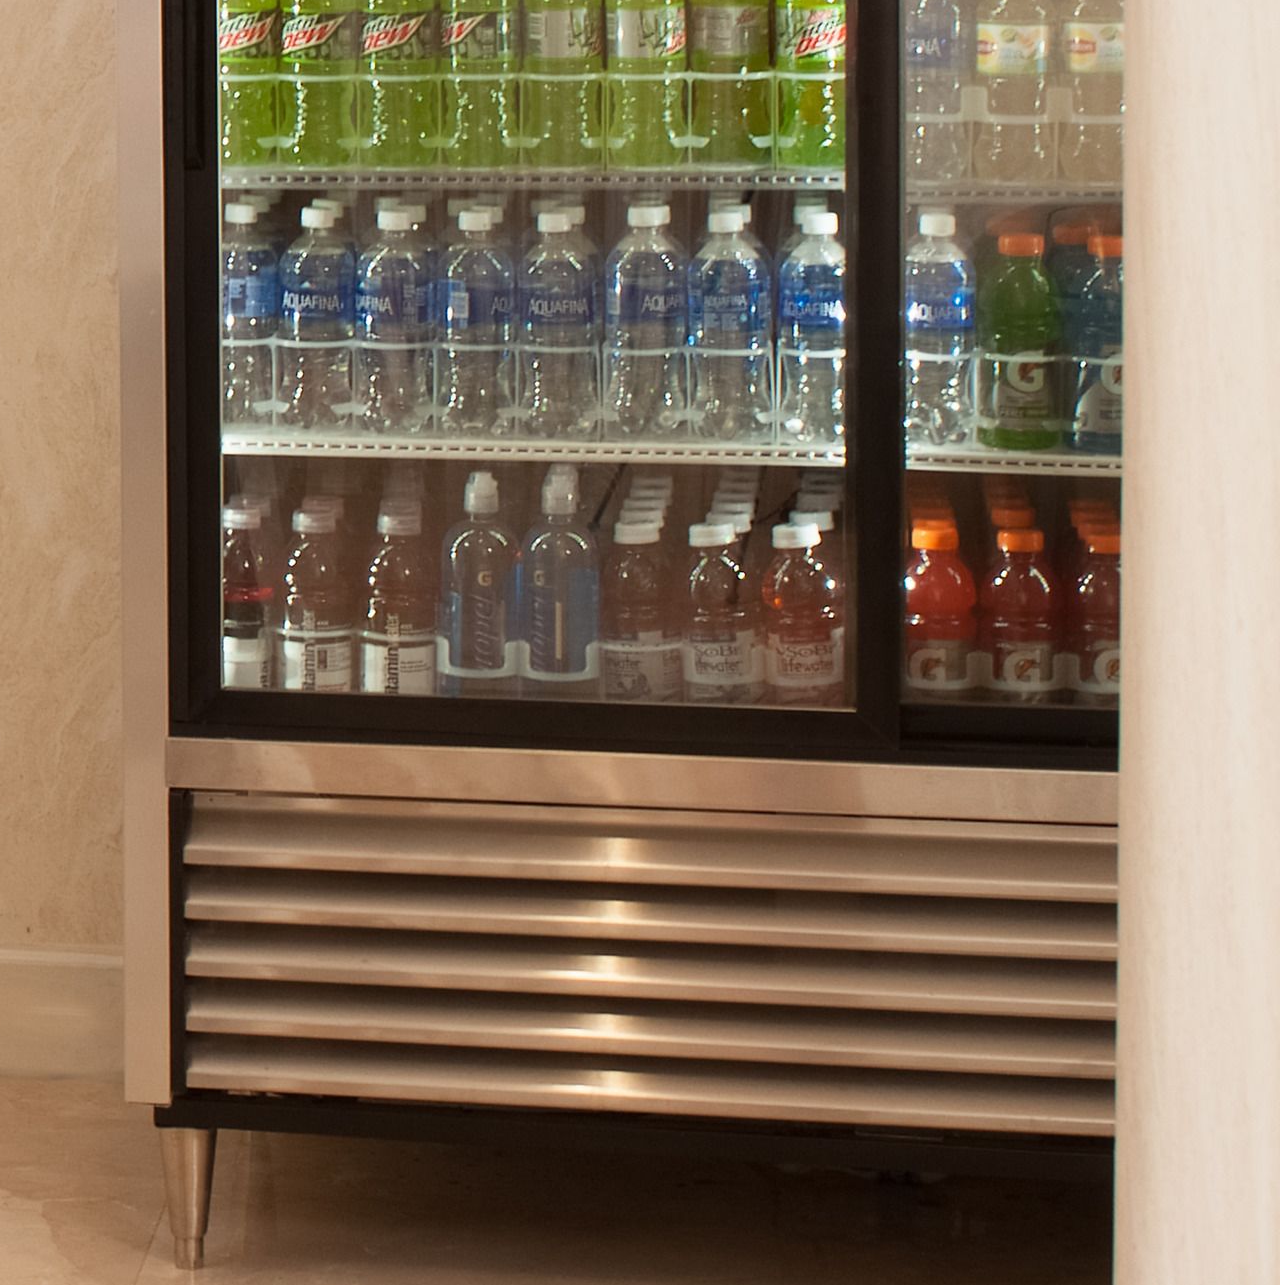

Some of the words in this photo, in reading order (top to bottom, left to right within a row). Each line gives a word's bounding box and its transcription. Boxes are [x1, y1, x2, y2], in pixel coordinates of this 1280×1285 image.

[282, 290, 340, 313] AQUAFINA
[528, 297, 590, 316] AQUAFINA
[1007, 350, 1044, 393] G
